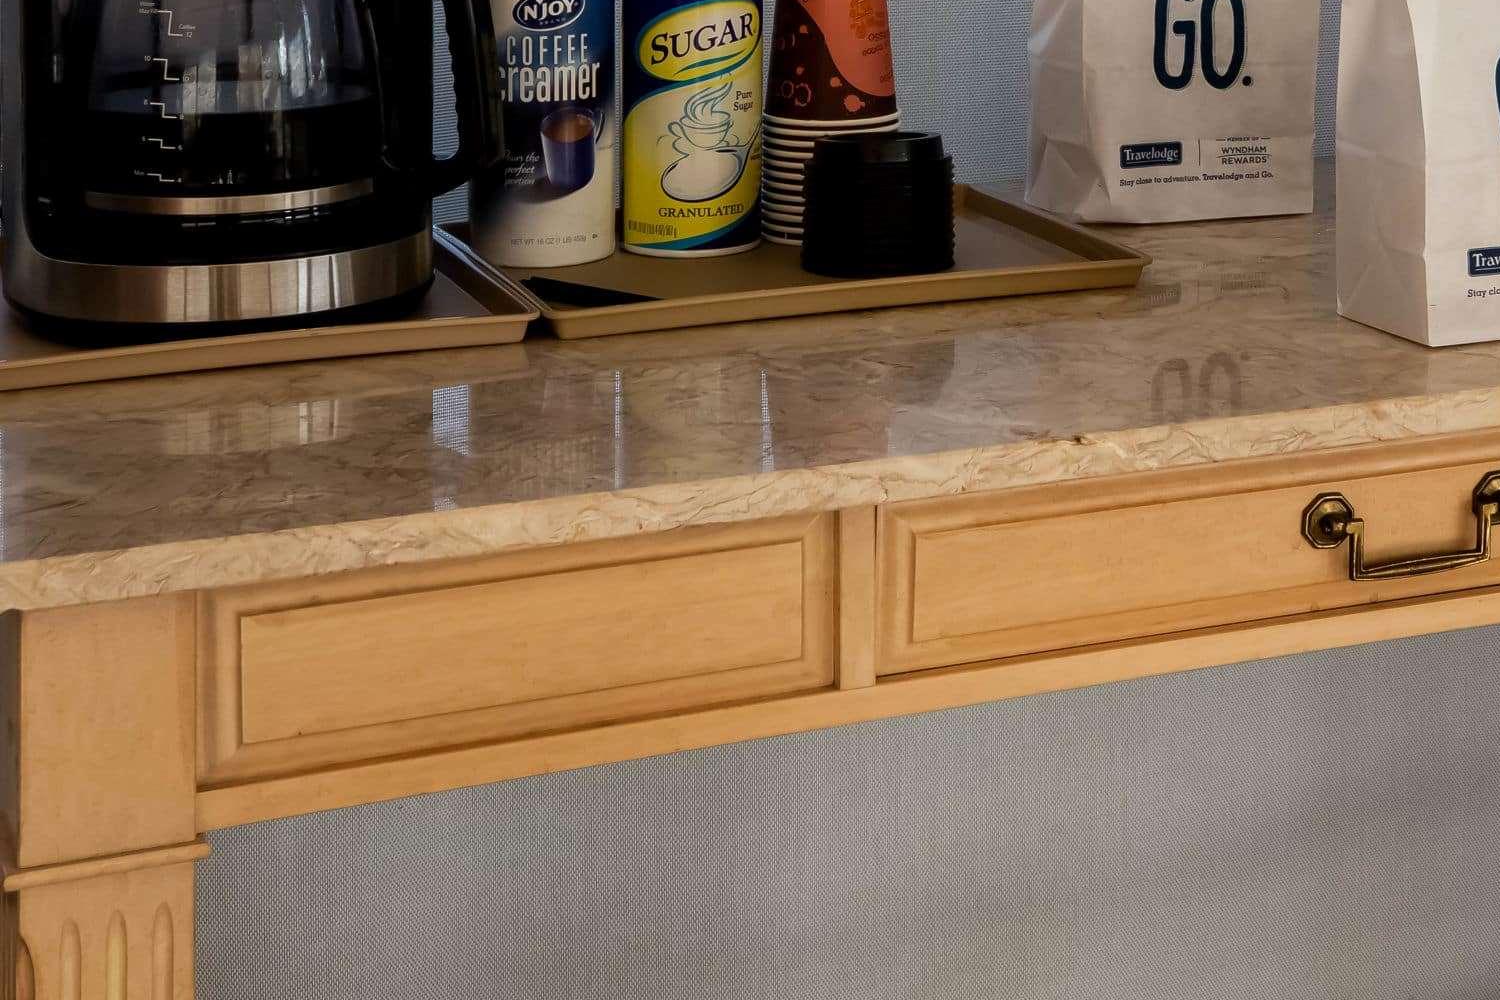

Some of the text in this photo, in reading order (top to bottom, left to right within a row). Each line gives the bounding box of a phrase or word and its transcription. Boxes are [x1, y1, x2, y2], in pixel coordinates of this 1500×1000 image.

[651, 12, 757, 66] SUGAR
[506, 33, 588, 67] COFFEE
[736, 91, 753, 100] Pure
[733, 102, 753, 112] Sugar
[1123, 147, 1179, 162] Travelodge
[1221, 146, 1267, 154] WYNDHAM
[1221, 156, 1267, 165] REWARDS
[1120, 179, 1135, 187] Stay
[1136, 177, 1153, 185] close
[1245, 171, 1260, 179] and
[658, 204, 744, 218] GRANULATED
[1467, 287, 1487, 298] Stay
